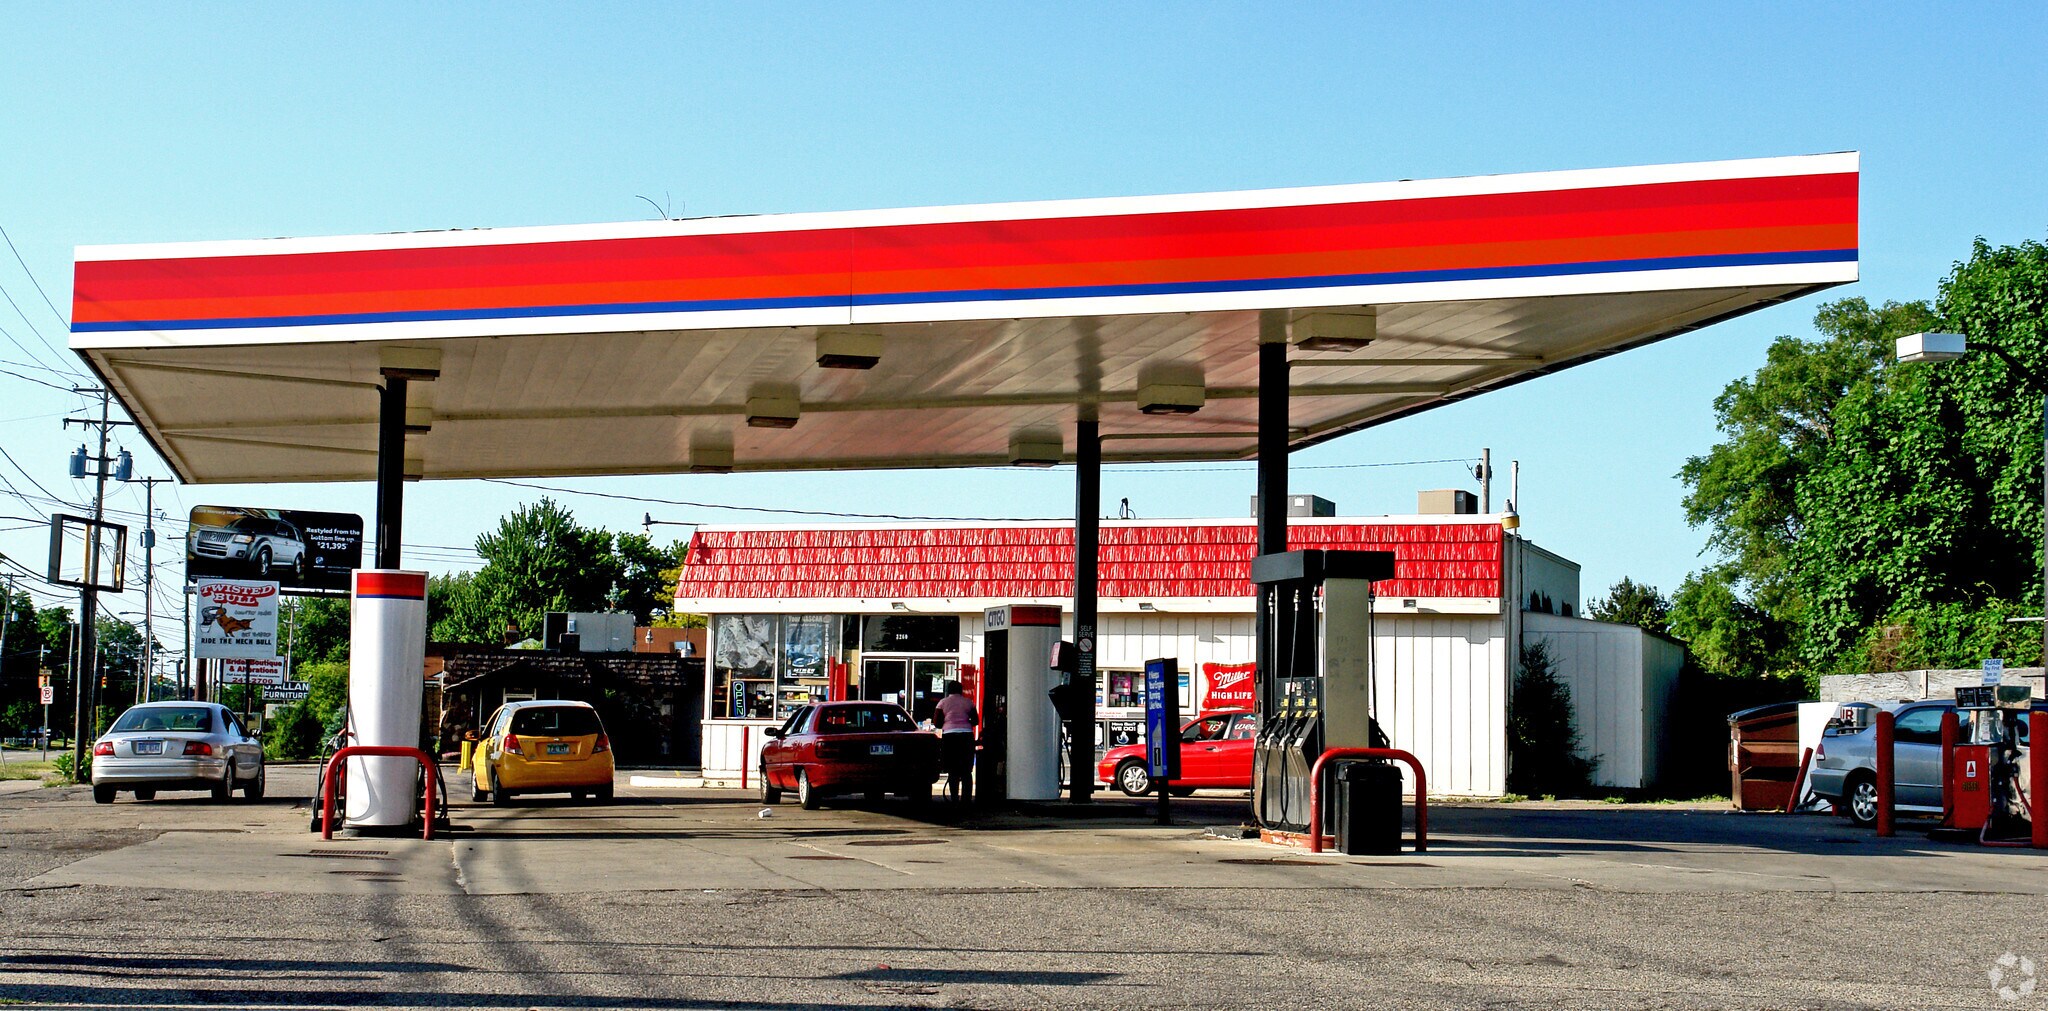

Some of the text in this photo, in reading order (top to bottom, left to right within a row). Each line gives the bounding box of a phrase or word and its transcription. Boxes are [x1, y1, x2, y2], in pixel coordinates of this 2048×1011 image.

[200, 584, 275, 596] TWISTED
[213, 592, 258, 606] BULL
[988, 609, 1005, 627] CITGO
[1214, 671, 1250, 688] Miller
[734, 683, 744, 715] OPEN
